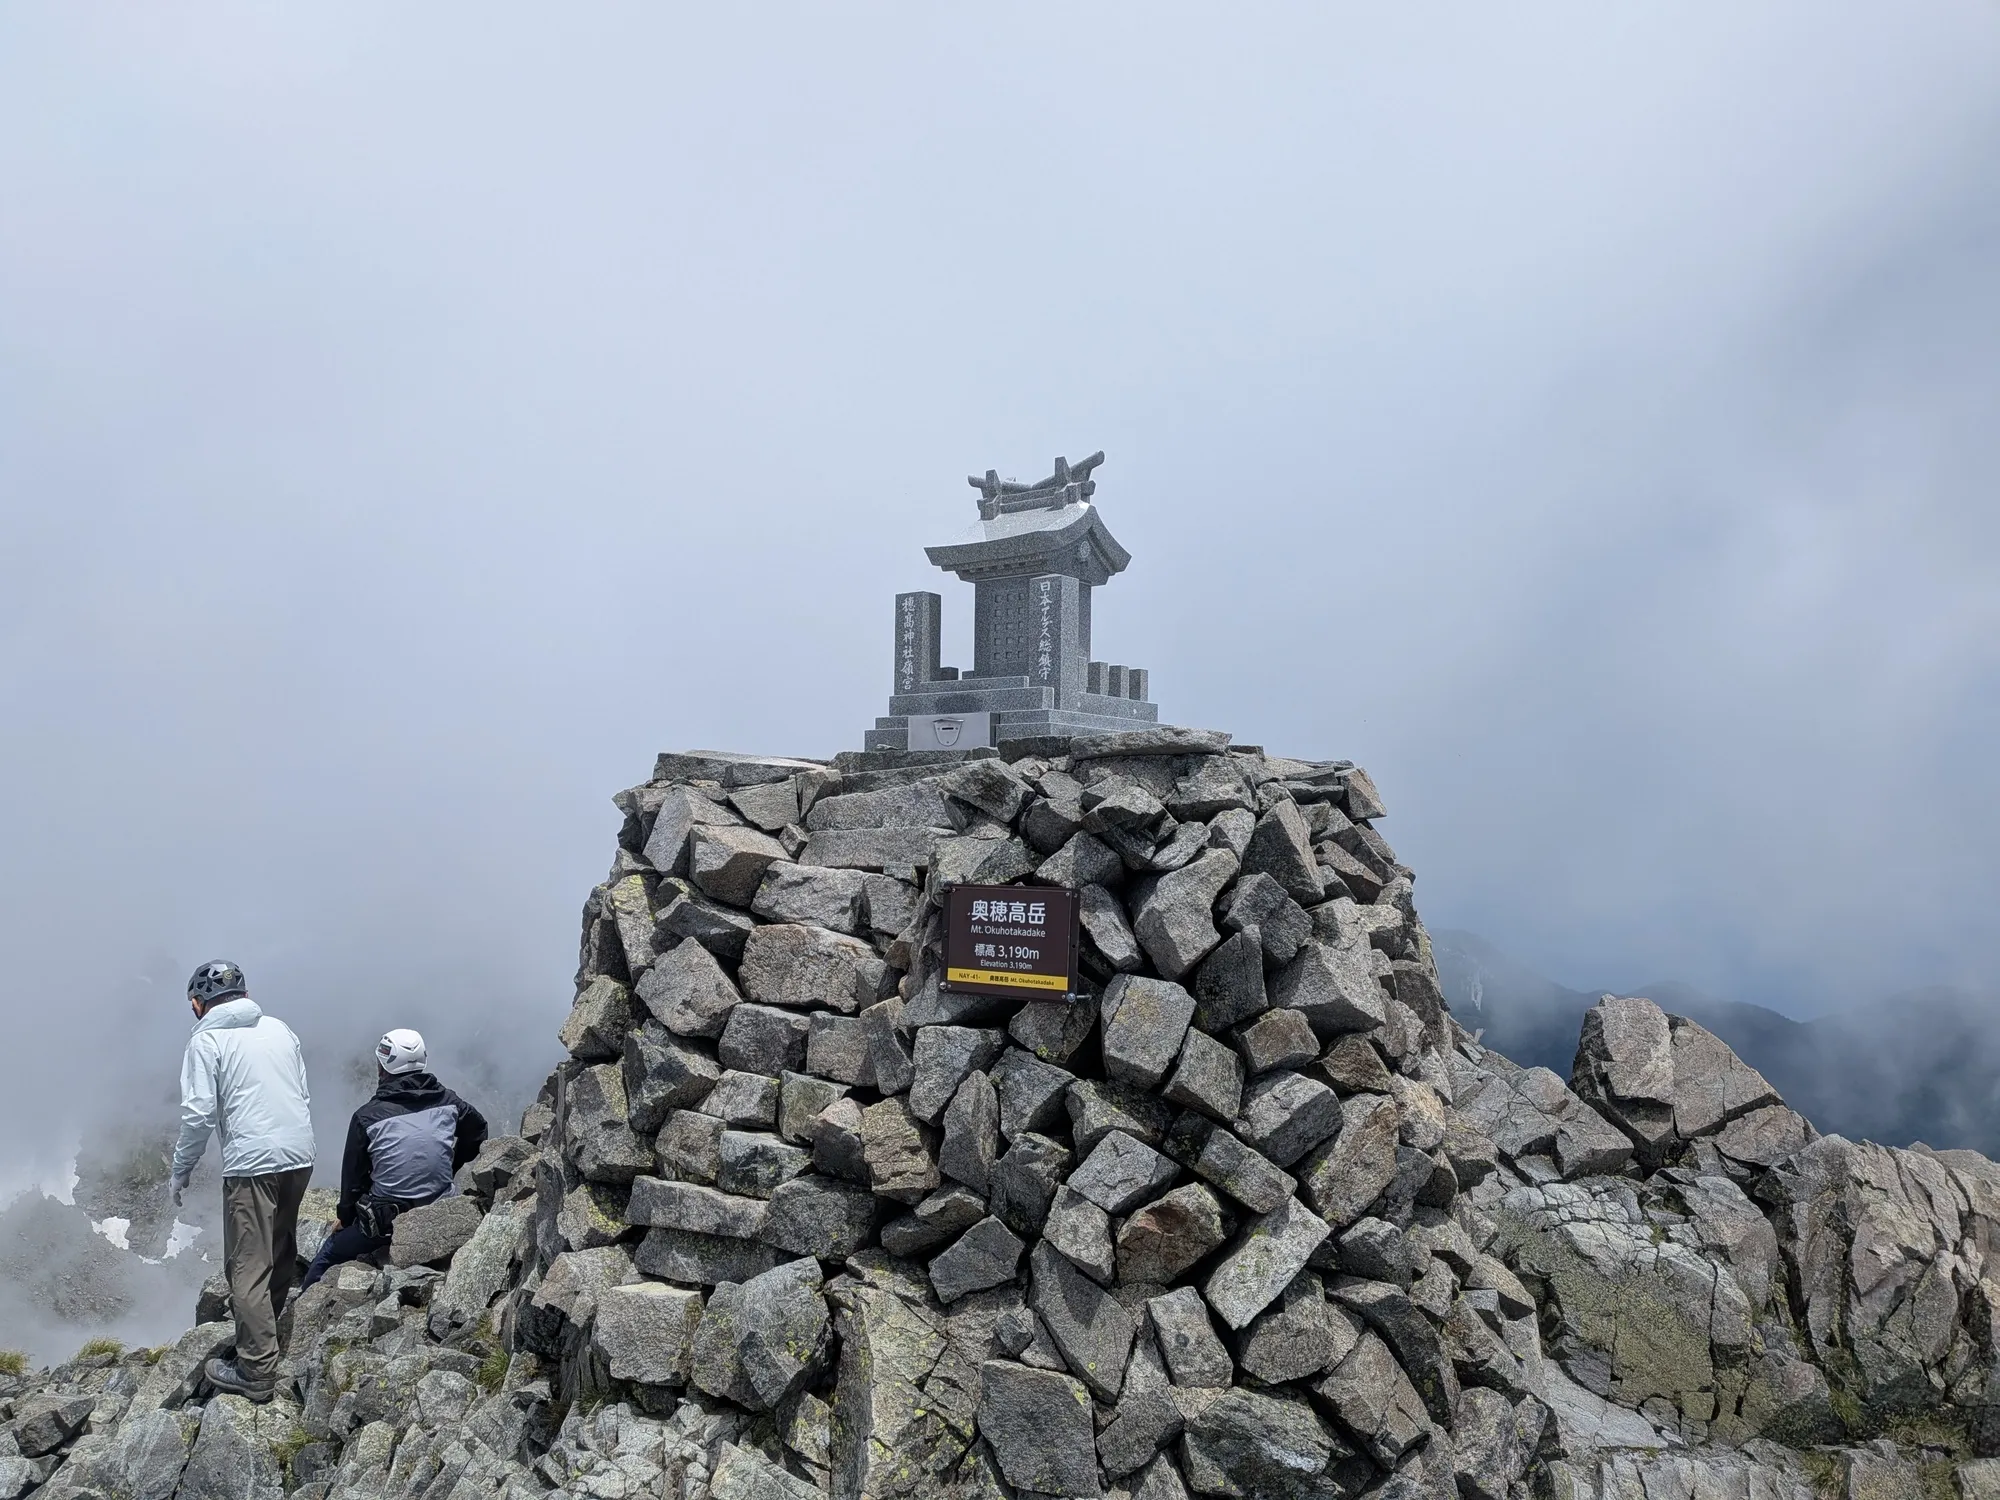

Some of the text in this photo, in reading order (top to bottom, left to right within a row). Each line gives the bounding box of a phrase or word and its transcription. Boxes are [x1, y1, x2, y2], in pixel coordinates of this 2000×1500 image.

[971, 899, 1046, 925] 奥穂高岳
[970, 924, 1046, 938] Mt. Okuhotakadake
[974, 943, 1040, 960] 標高 3,190m
[980, 959, 1008, 968] Elevation
[1018, 977, 1055, 986] Okuhotakadake
